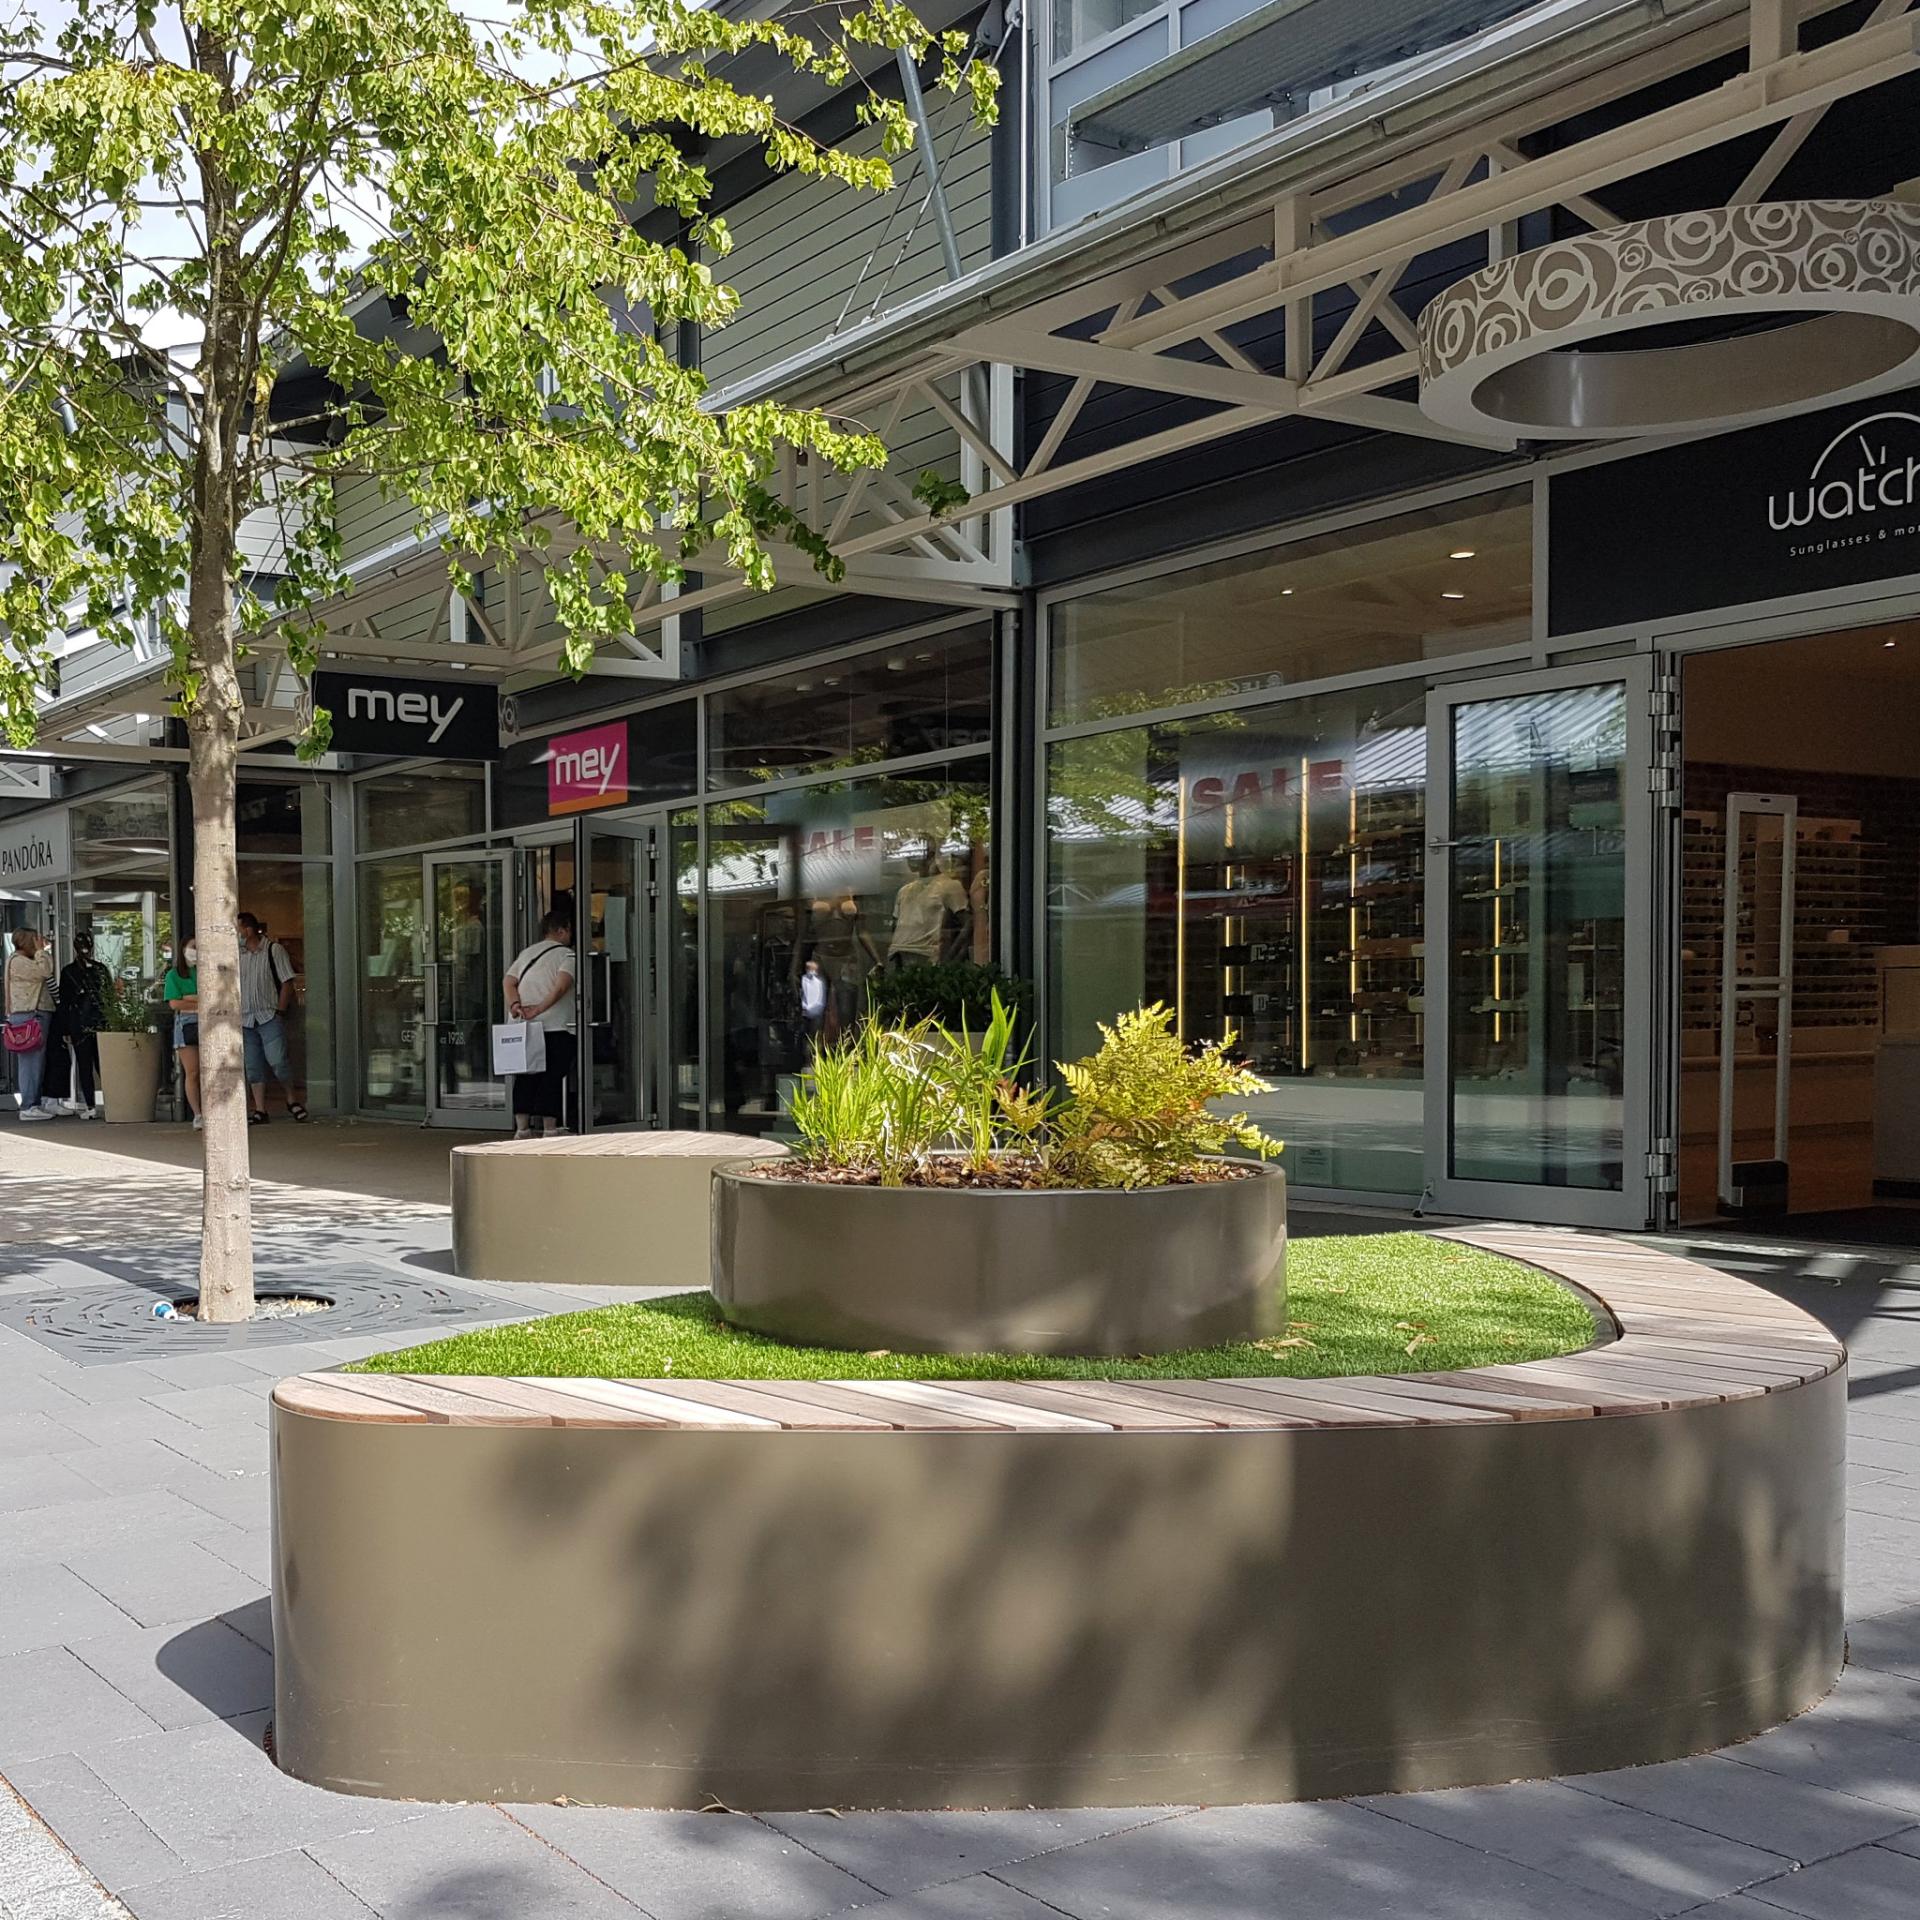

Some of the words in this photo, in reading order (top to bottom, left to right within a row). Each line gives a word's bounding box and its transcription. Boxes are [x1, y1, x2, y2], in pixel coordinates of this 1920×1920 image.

[1789, 533, 1871, 557] Sunglasses
[1878, 529, 1887, 540] &
[347, 687, 464, 743] mey
[555, 743, 620, 796] mey
[1191, 759, 1343, 808] SALE
[787, 826, 874, 855] ALE
